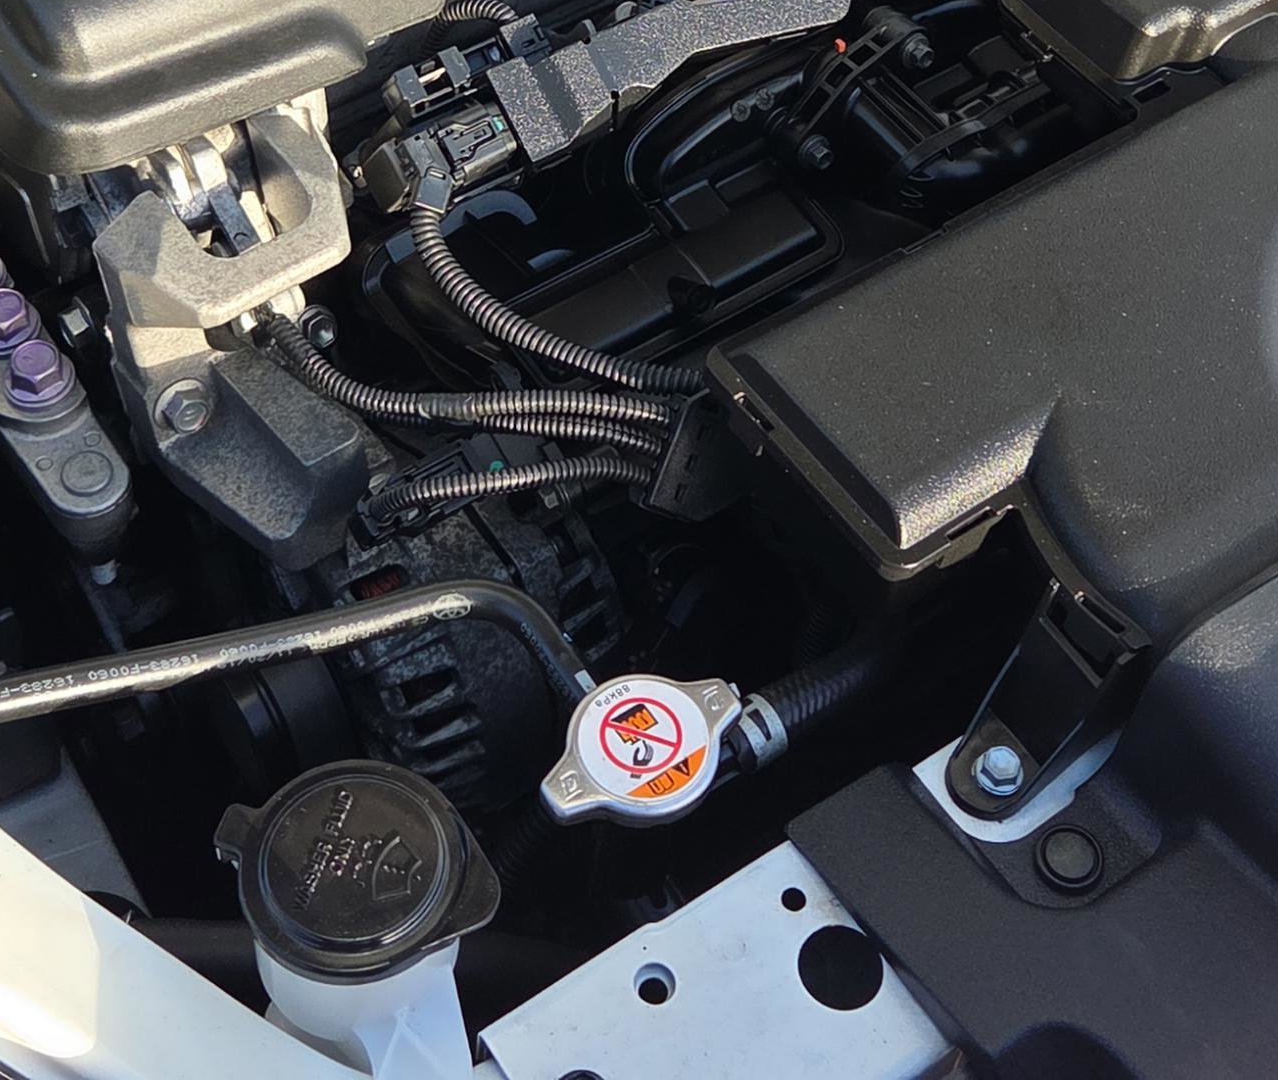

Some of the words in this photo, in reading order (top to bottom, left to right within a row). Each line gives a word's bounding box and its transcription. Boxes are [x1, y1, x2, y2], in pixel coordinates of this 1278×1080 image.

[594, 683, 631, 709] 88kPa
[292, 841, 333, 911] WASHER
[324, 790, 353, 838] FLUID
[329, 837, 356, 877] ONLY
